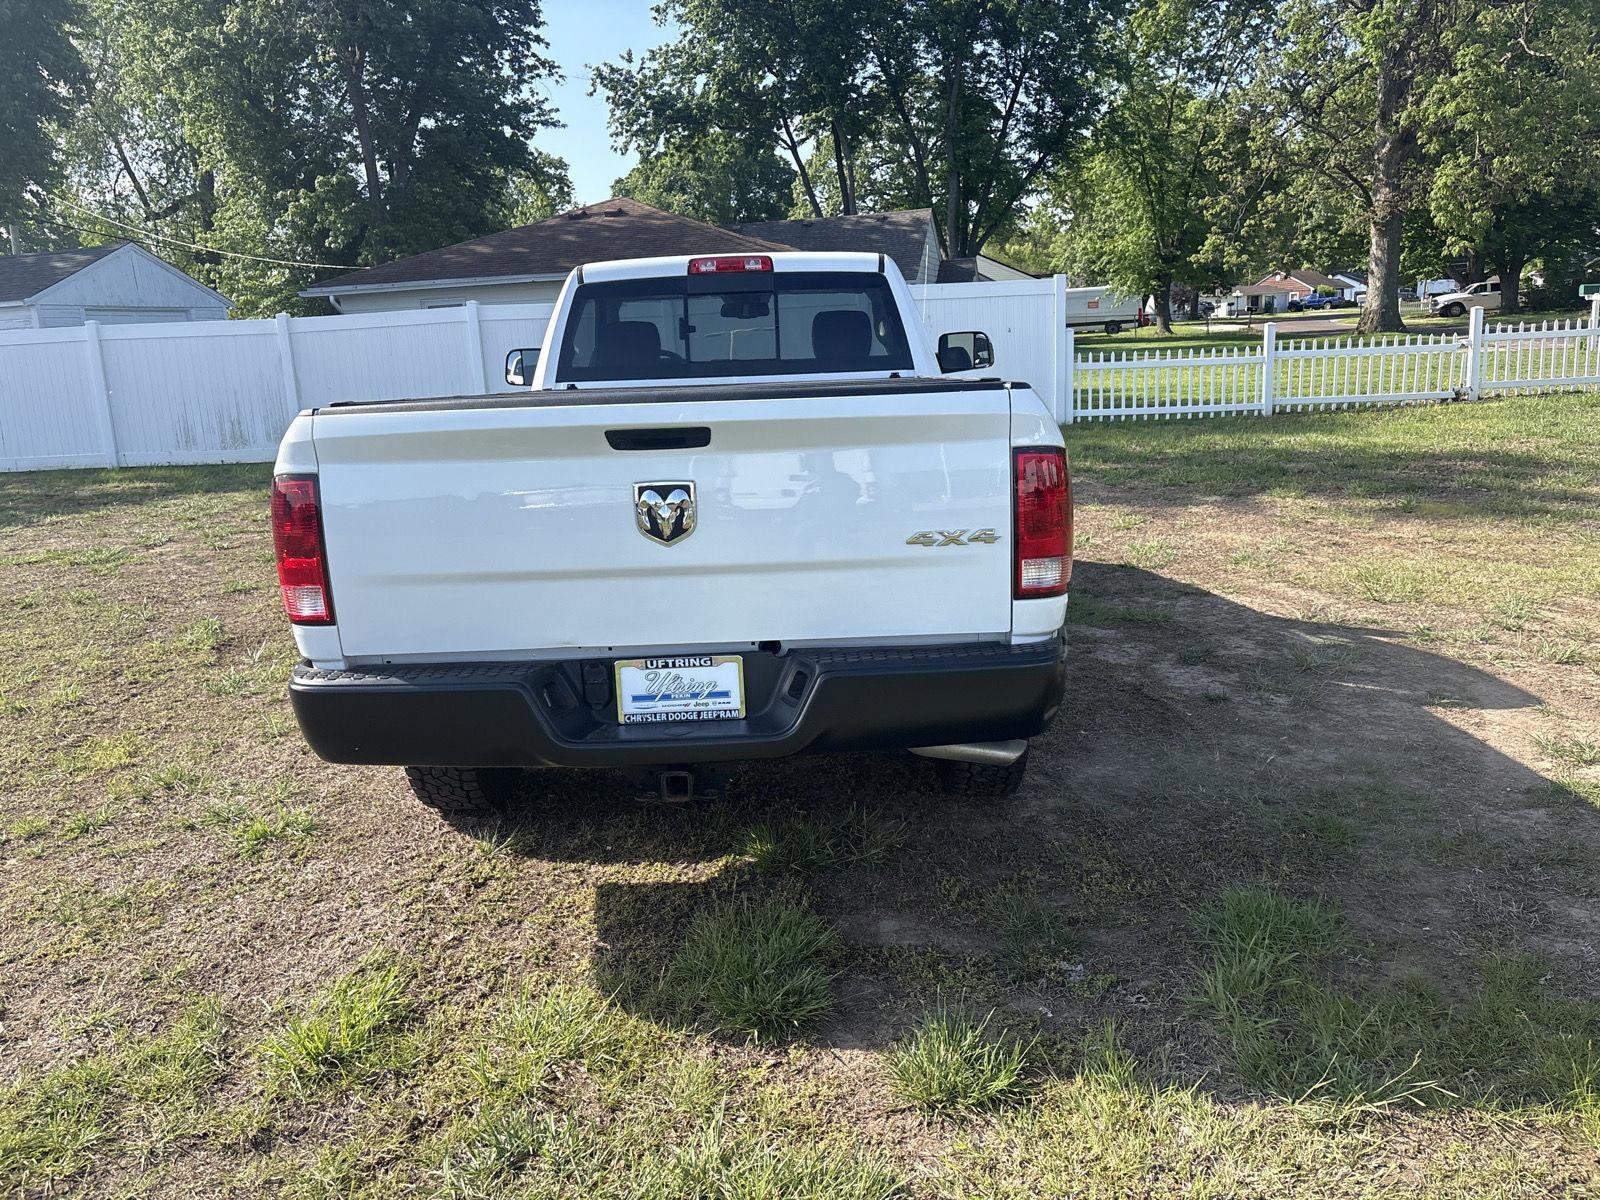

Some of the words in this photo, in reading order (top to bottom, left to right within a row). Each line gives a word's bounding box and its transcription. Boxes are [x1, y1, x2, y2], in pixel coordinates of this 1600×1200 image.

[906, 528, 1002, 546] 4X4
[646, 657, 712, 669] UFTRING
[645, 670, 718, 702] Uftring
[624, 713, 668, 723] CHRYSLER
[668, 711, 698, 721] DODGE
[719, 709, 739, 719] RAM
